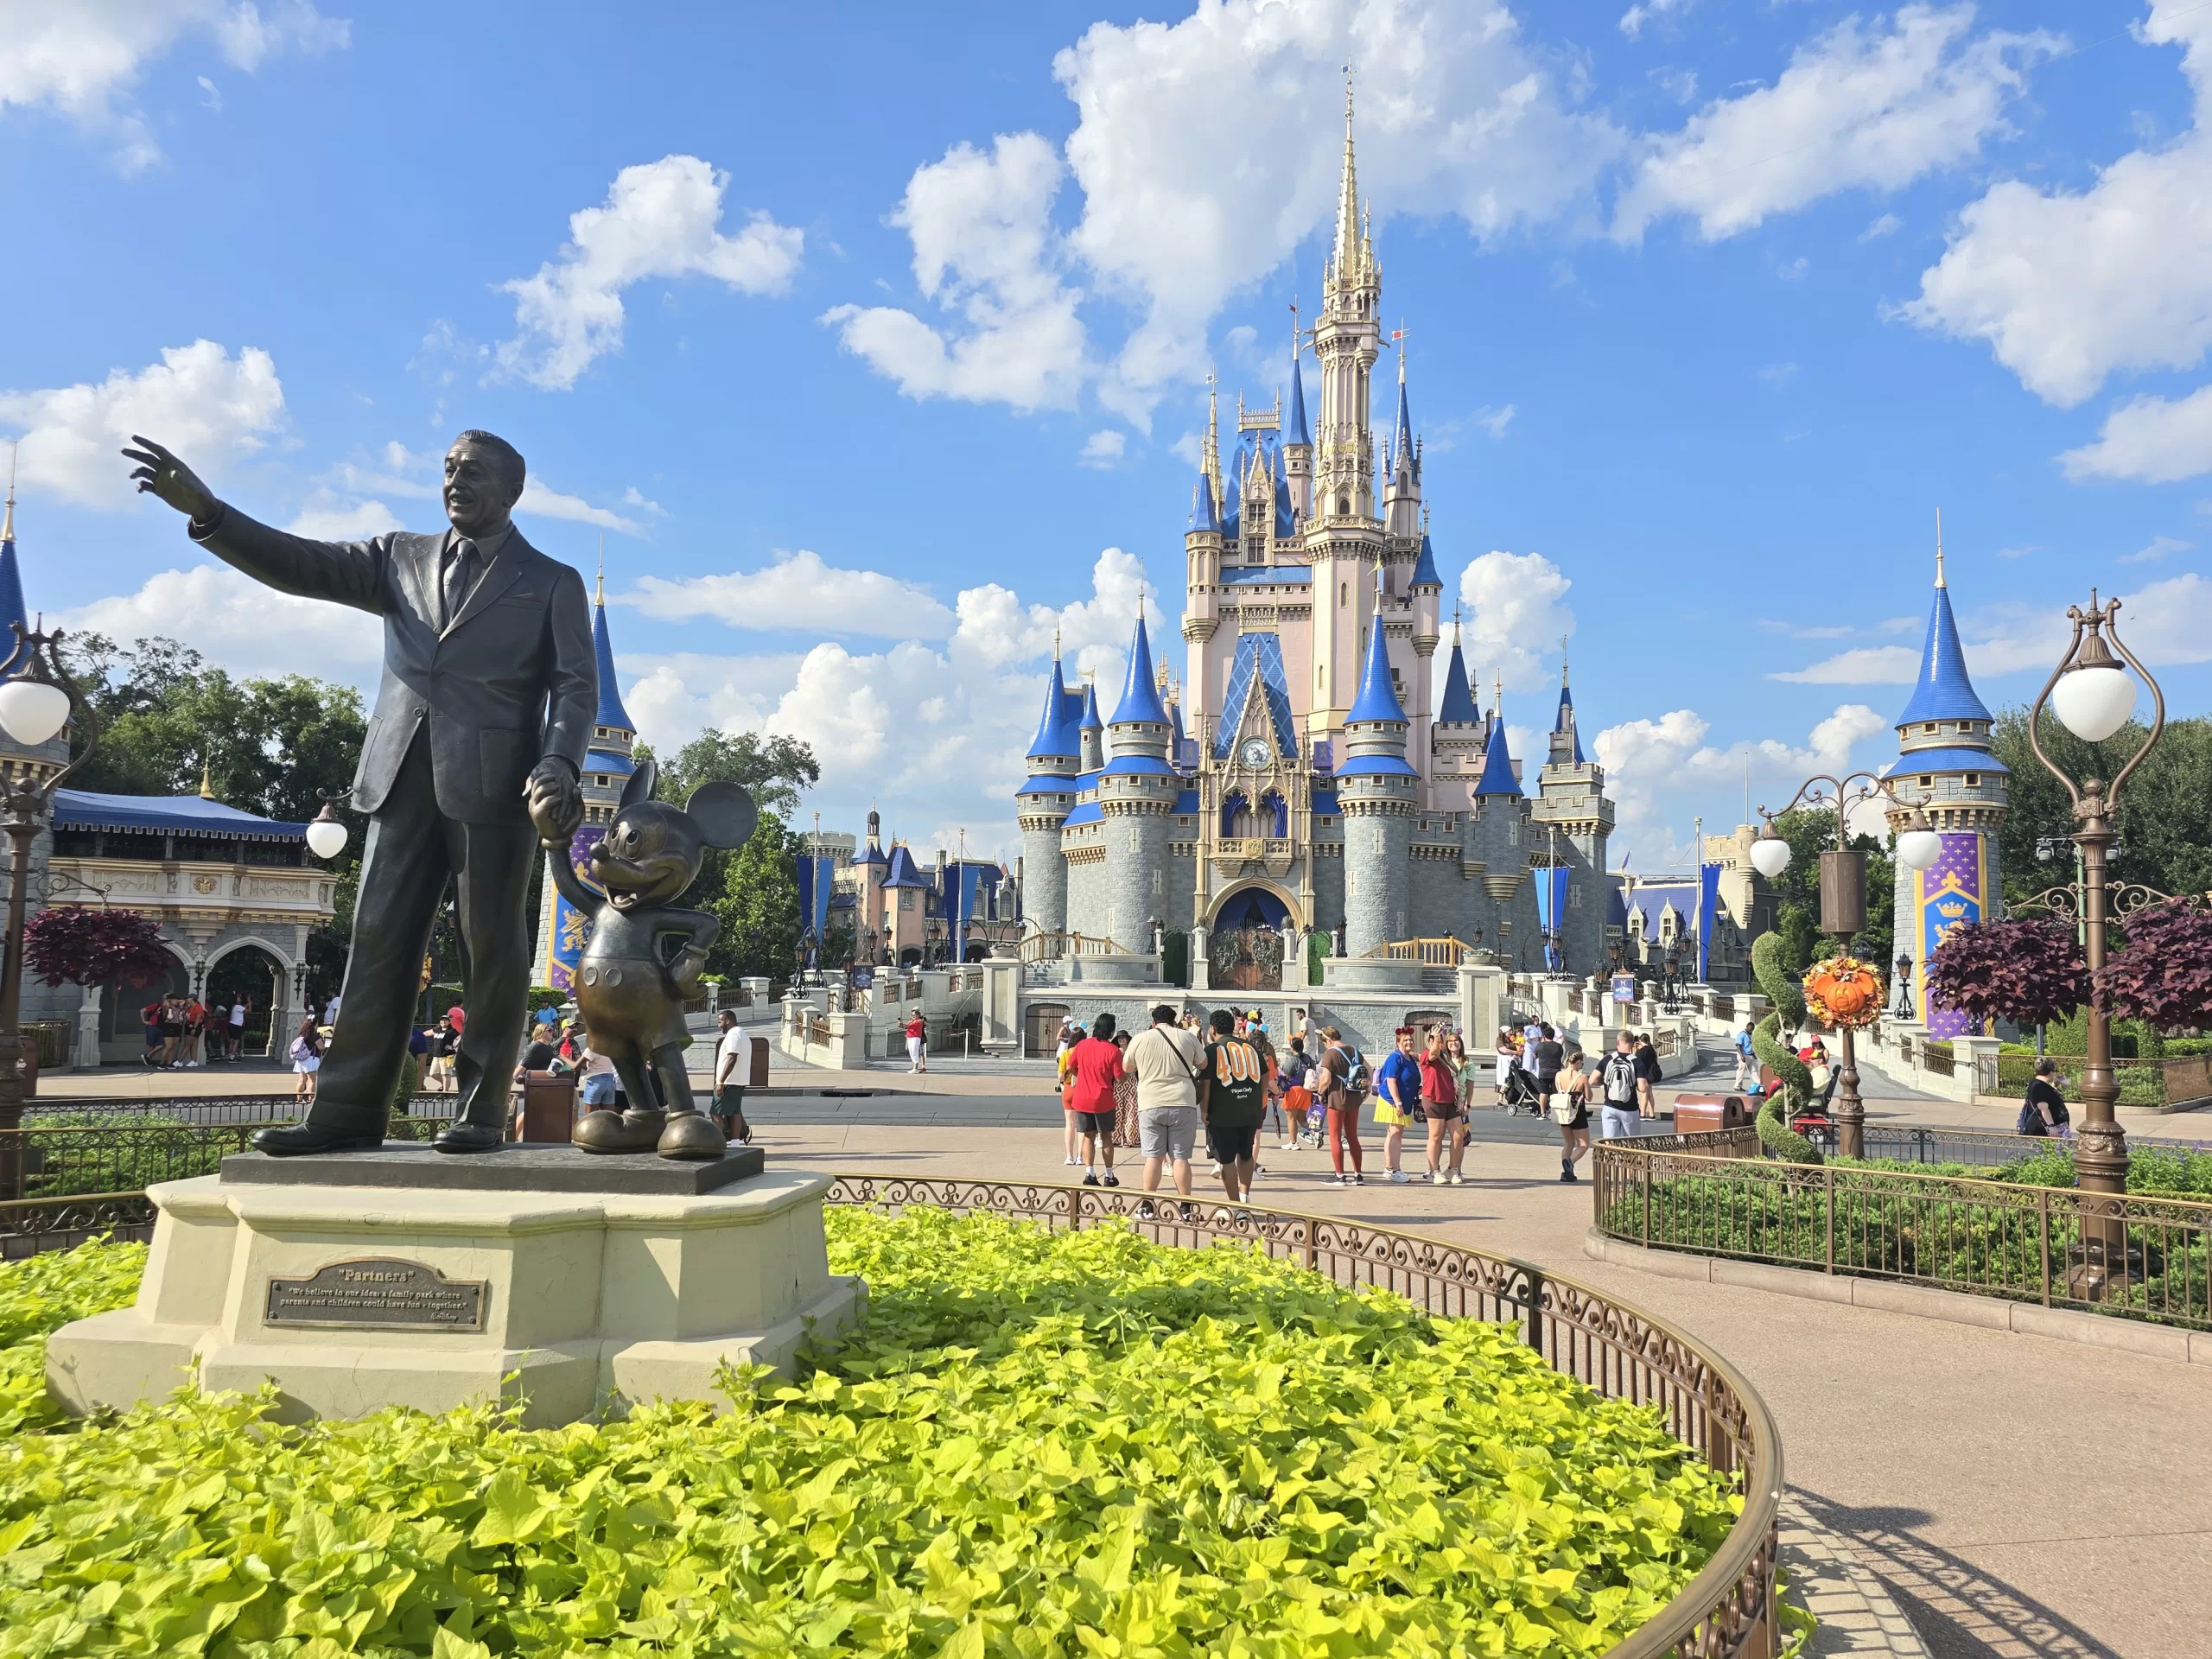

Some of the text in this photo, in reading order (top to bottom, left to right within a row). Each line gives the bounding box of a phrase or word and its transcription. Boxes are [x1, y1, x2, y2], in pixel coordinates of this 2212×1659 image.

[1217, 1041, 1261, 1087] 400
[339, 1268, 415, 1282] “Partners”
[305, 1287, 333, 1296] believe
[389, 1289, 414, 1300] family
[416, 1291, 435, 1300] park
[280, 1299, 309, 1307] parents
[328, 1299, 361, 1307] children
[387, 1300, 405, 1308] have
